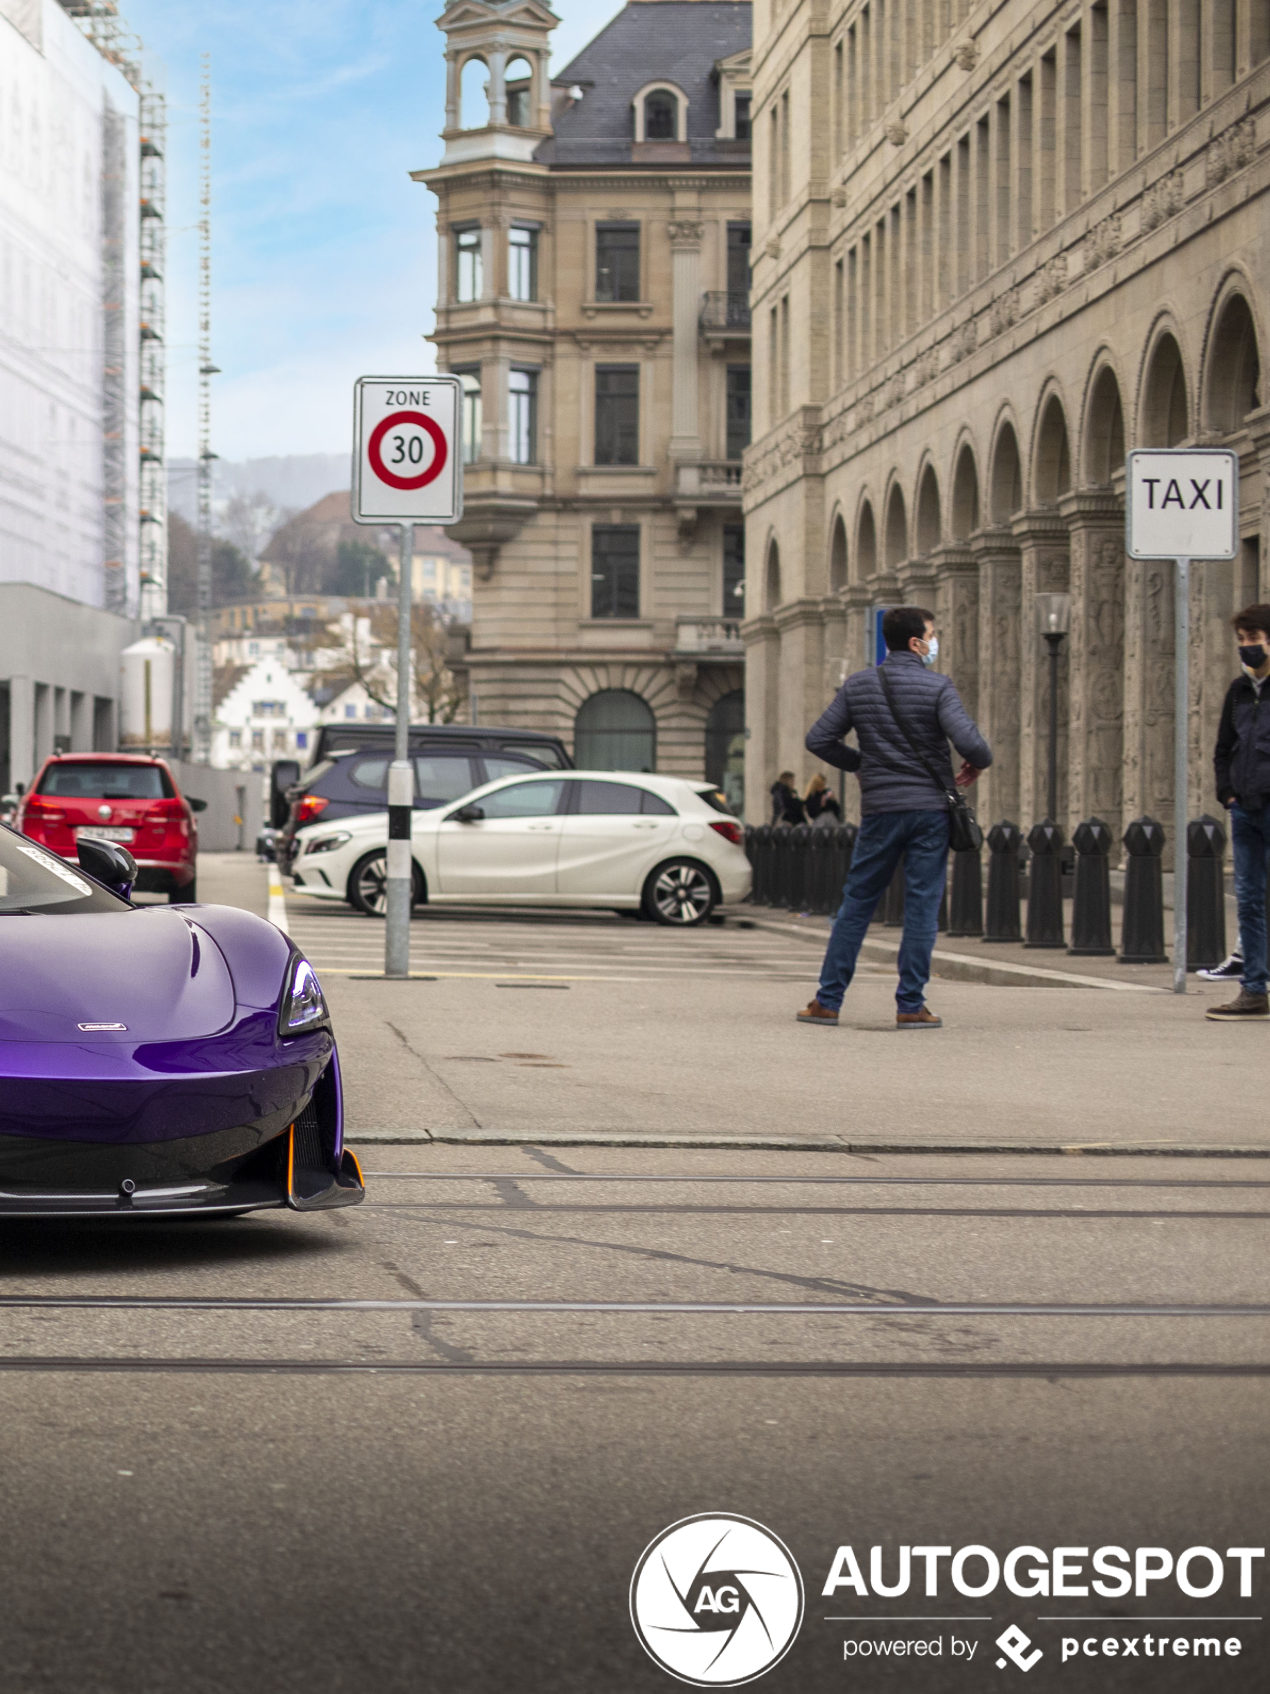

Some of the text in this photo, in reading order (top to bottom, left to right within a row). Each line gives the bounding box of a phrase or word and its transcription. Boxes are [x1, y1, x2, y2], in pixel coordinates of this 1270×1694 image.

[385, 391, 430, 406] ZONE
[391, 436, 424, 464] 30
[1141, 478, 1224, 510] TAXI
